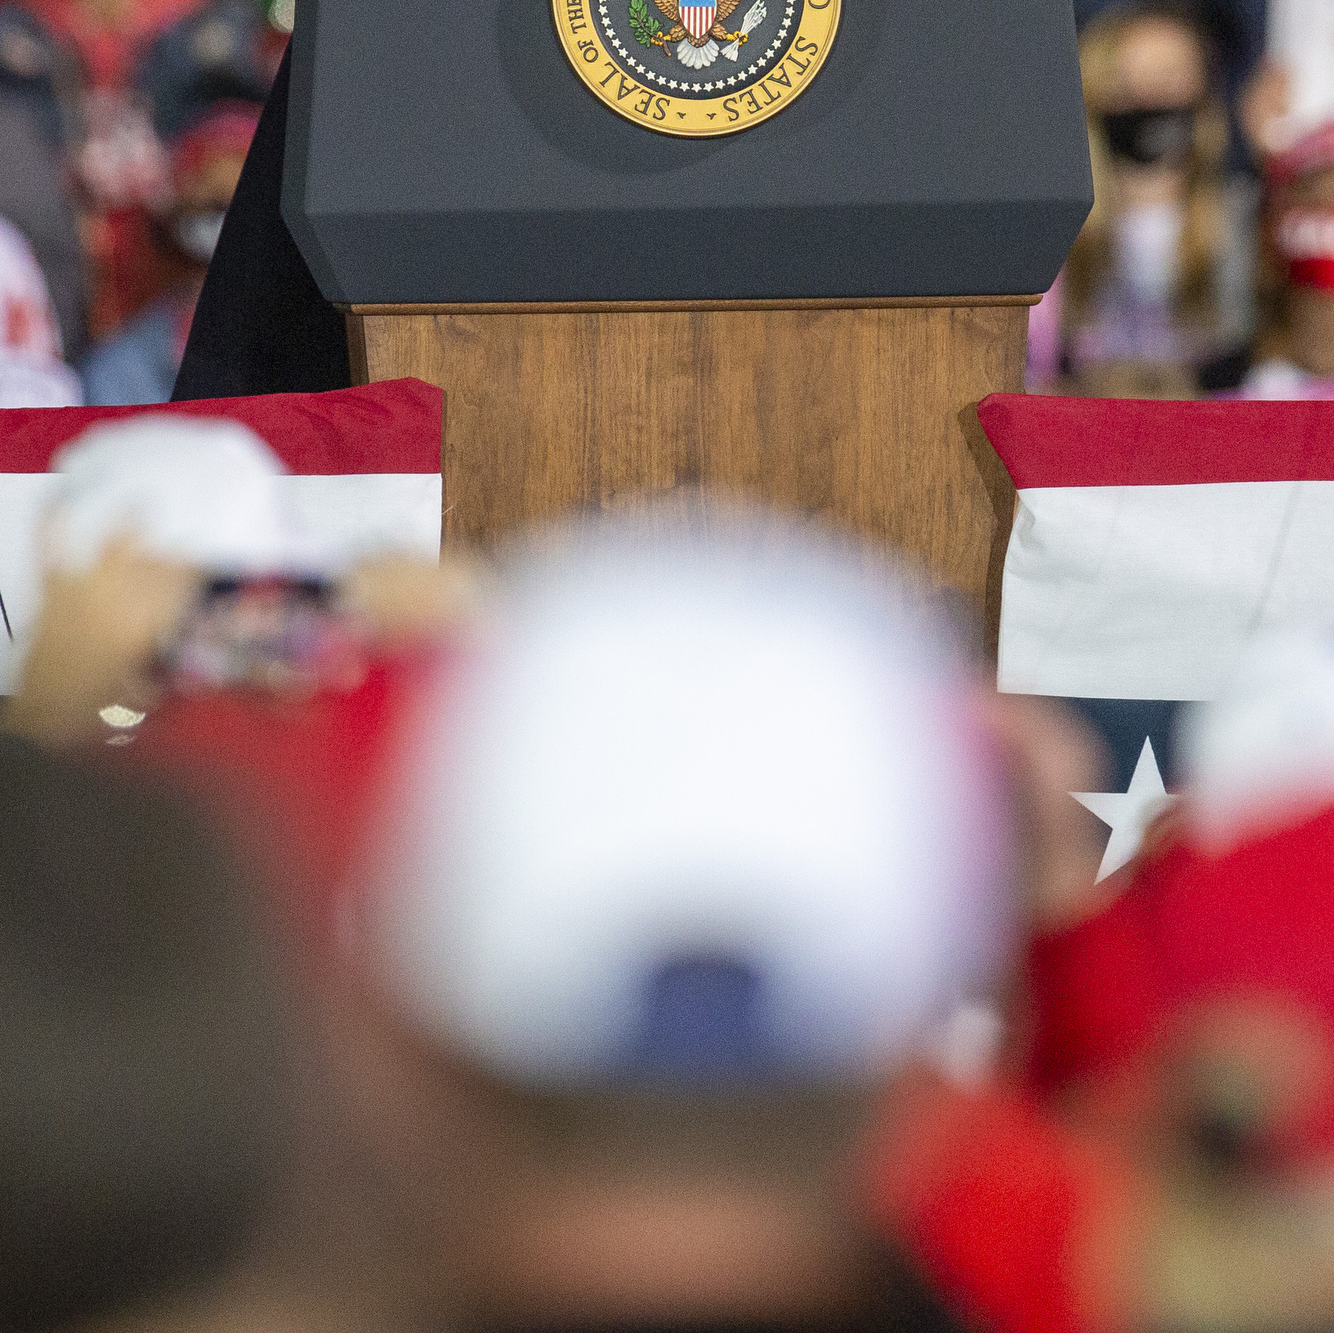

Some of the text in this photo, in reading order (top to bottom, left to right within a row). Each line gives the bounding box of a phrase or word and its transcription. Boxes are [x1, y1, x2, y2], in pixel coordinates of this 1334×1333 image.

[578, 37, 599, 63] OF
[599, 66, 671, 122] SEAL
[723, 35, 819, 122] STATES
